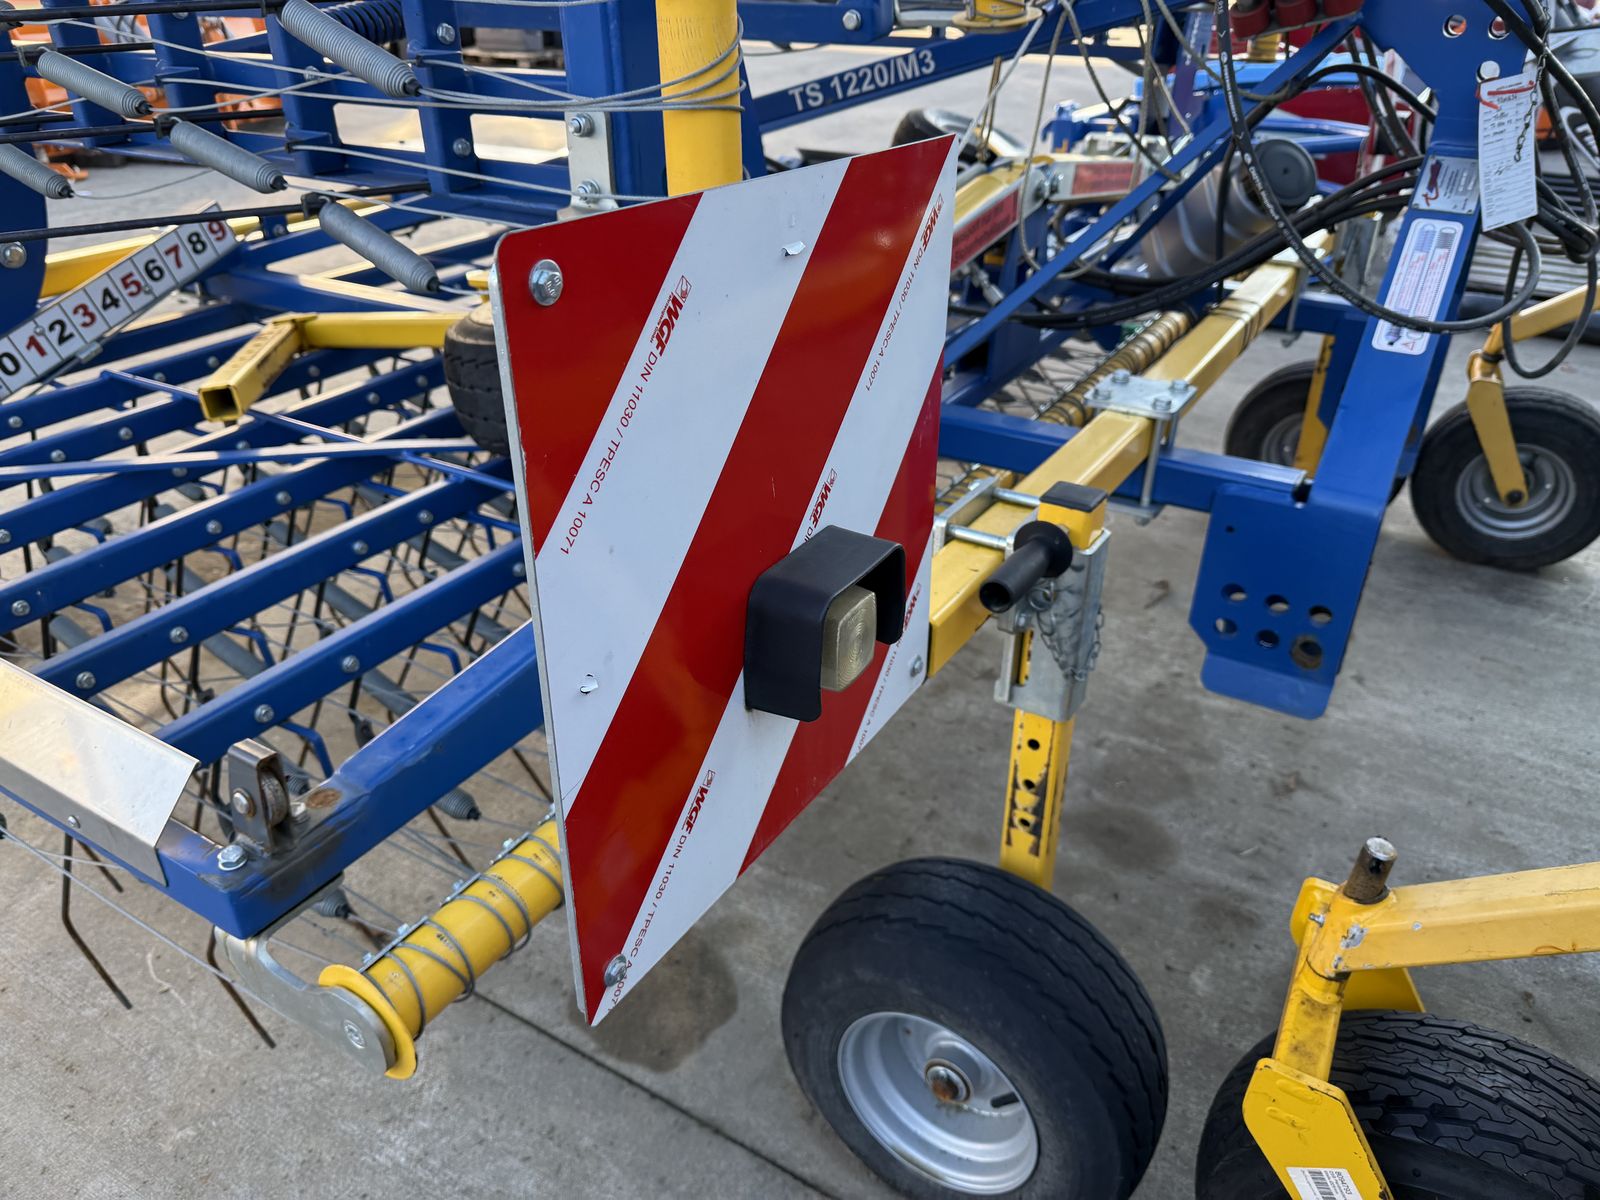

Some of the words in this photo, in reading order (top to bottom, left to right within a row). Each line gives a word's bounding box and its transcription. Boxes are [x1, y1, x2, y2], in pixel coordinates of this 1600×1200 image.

[788, 82, 824, 112] TS
[829, 49, 936, 100] 1220/M3
[920, 205, 939, 251] WGF
[913, 247, 924, 271] DIN
[0, 352, 21, 377] 0
[26, 335, 48, 358] 1
[48, 319, 76, 346] 2
[72, 303, 97, 328] 3
[100, 287, 120, 311] 4
[120, 272, 142, 298] 5
[144, 258, 164, 282] 6
[164, 244, 184, 269] 7
[187, 231, 207, 255] 8
[207, 219, 227, 242] 9
[901, 272, 915, 303] 11030
[655, 292, 684, 357] WGF
[883, 309, 901, 349] TPESC
[640, 350, 658, 382] DIN
[878, 349, 885, 357] A
[865, 358, 881, 392] 10071
[619, 384, 644, 428] 11030
[616, 427, 624, 438] /
[589, 438, 621, 494] TPESC
[582, 493, 593, 506] A
[810, 481, 831, 529] WGF
[560, 509, 587, 555] 10071
[684, 786, 709, 834] WGF
[672, 834, 687, 859] DIN
[655, 862, 675, 900] 11030
[630, 910, 654, 957] TPESC
[625, 959, 633, 969] A
